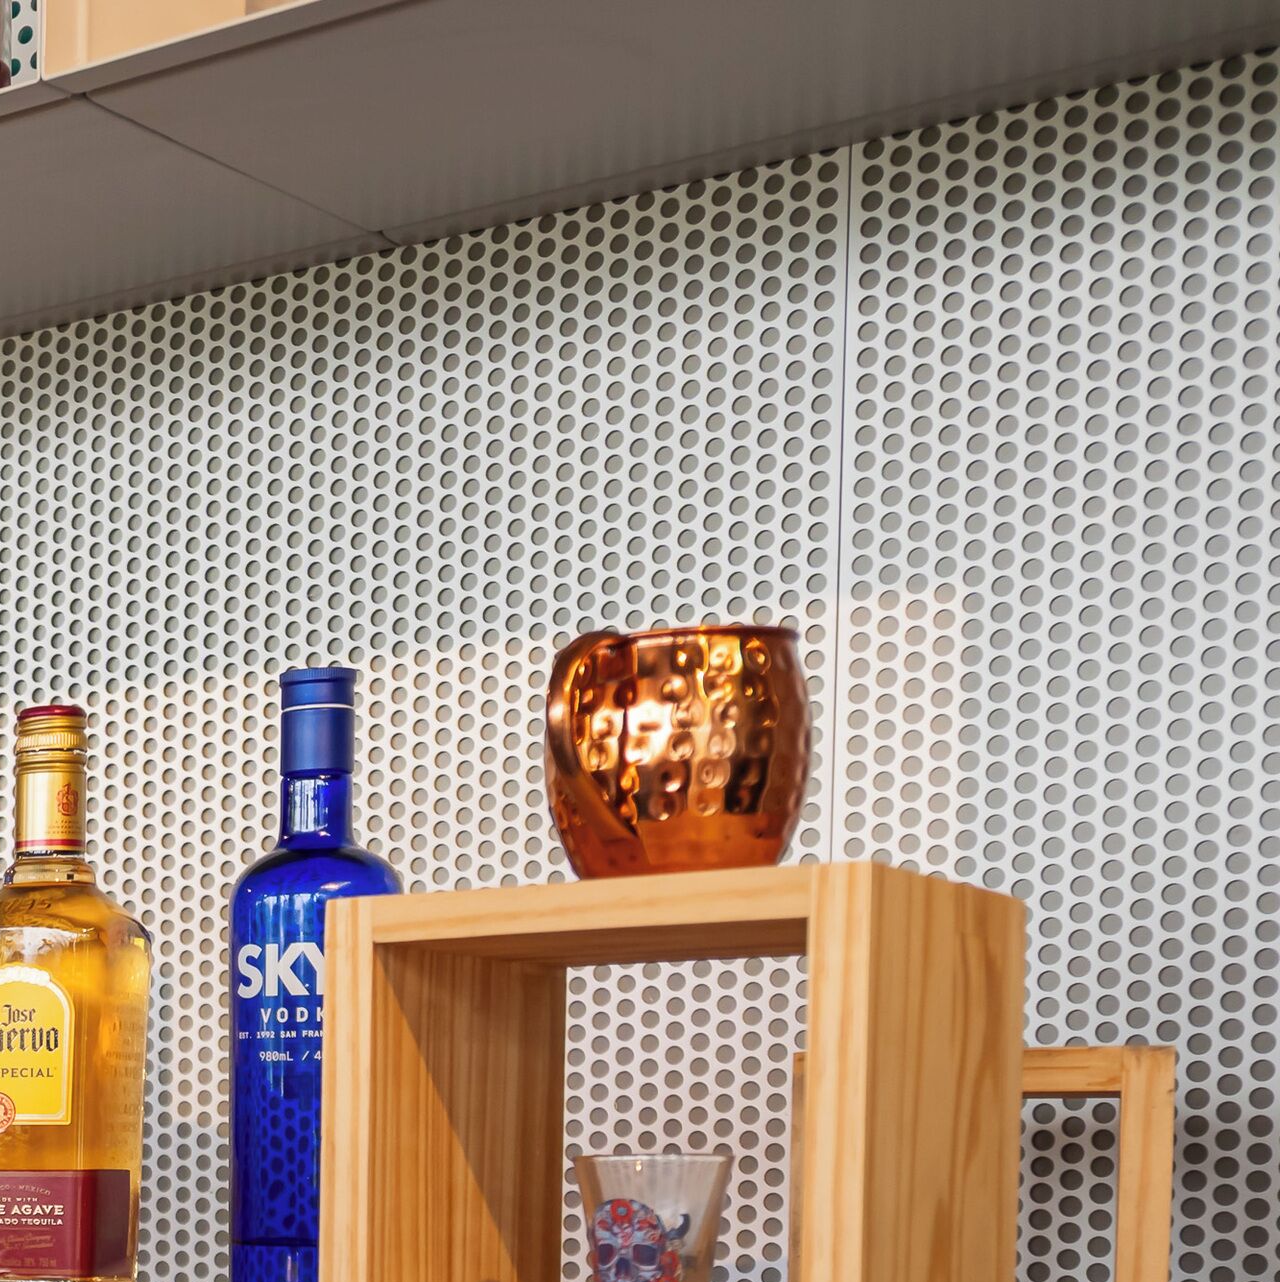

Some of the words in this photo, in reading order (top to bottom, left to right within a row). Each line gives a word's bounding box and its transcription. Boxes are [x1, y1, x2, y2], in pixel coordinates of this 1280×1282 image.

[1, 1004, 36, 1027] Jose
[256, 1030, 275, 1039] 1992
[280, 1030, 297, 1038] SAN
[11, 1204, 65, 1216] AGAVE
[21, 1217, 64, 1226] TEQUILA
